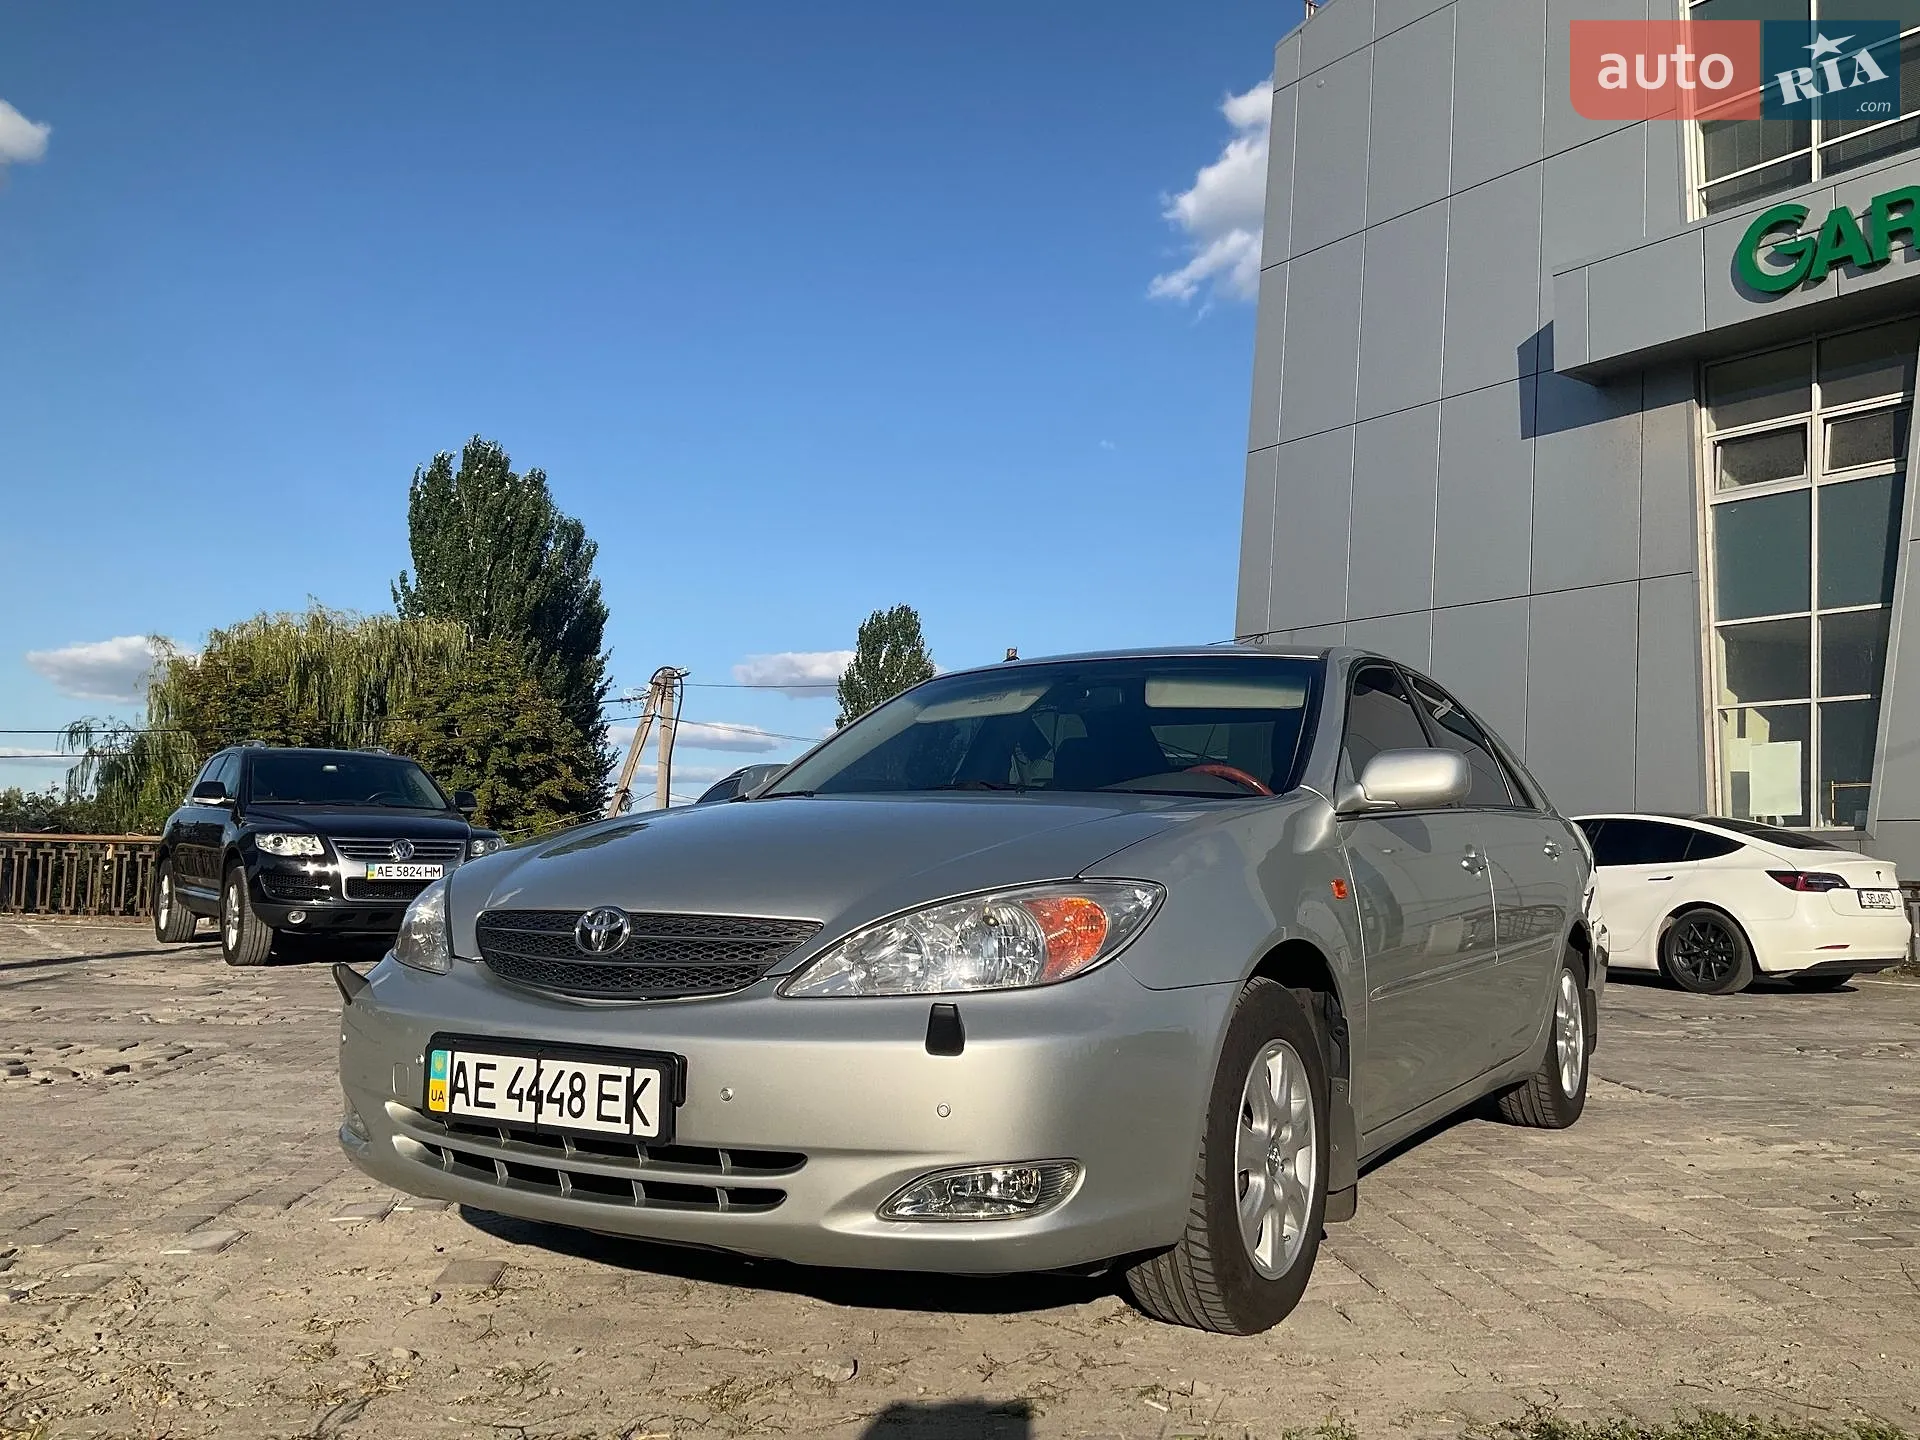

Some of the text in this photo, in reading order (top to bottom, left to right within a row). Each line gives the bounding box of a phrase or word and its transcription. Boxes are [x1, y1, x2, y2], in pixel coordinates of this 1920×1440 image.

[377, 866, 441, 877] AE 5824 HM
[431, 1089, 445, 1102] UA
[452, 1061, 652, 1127] AE 4448 EK
